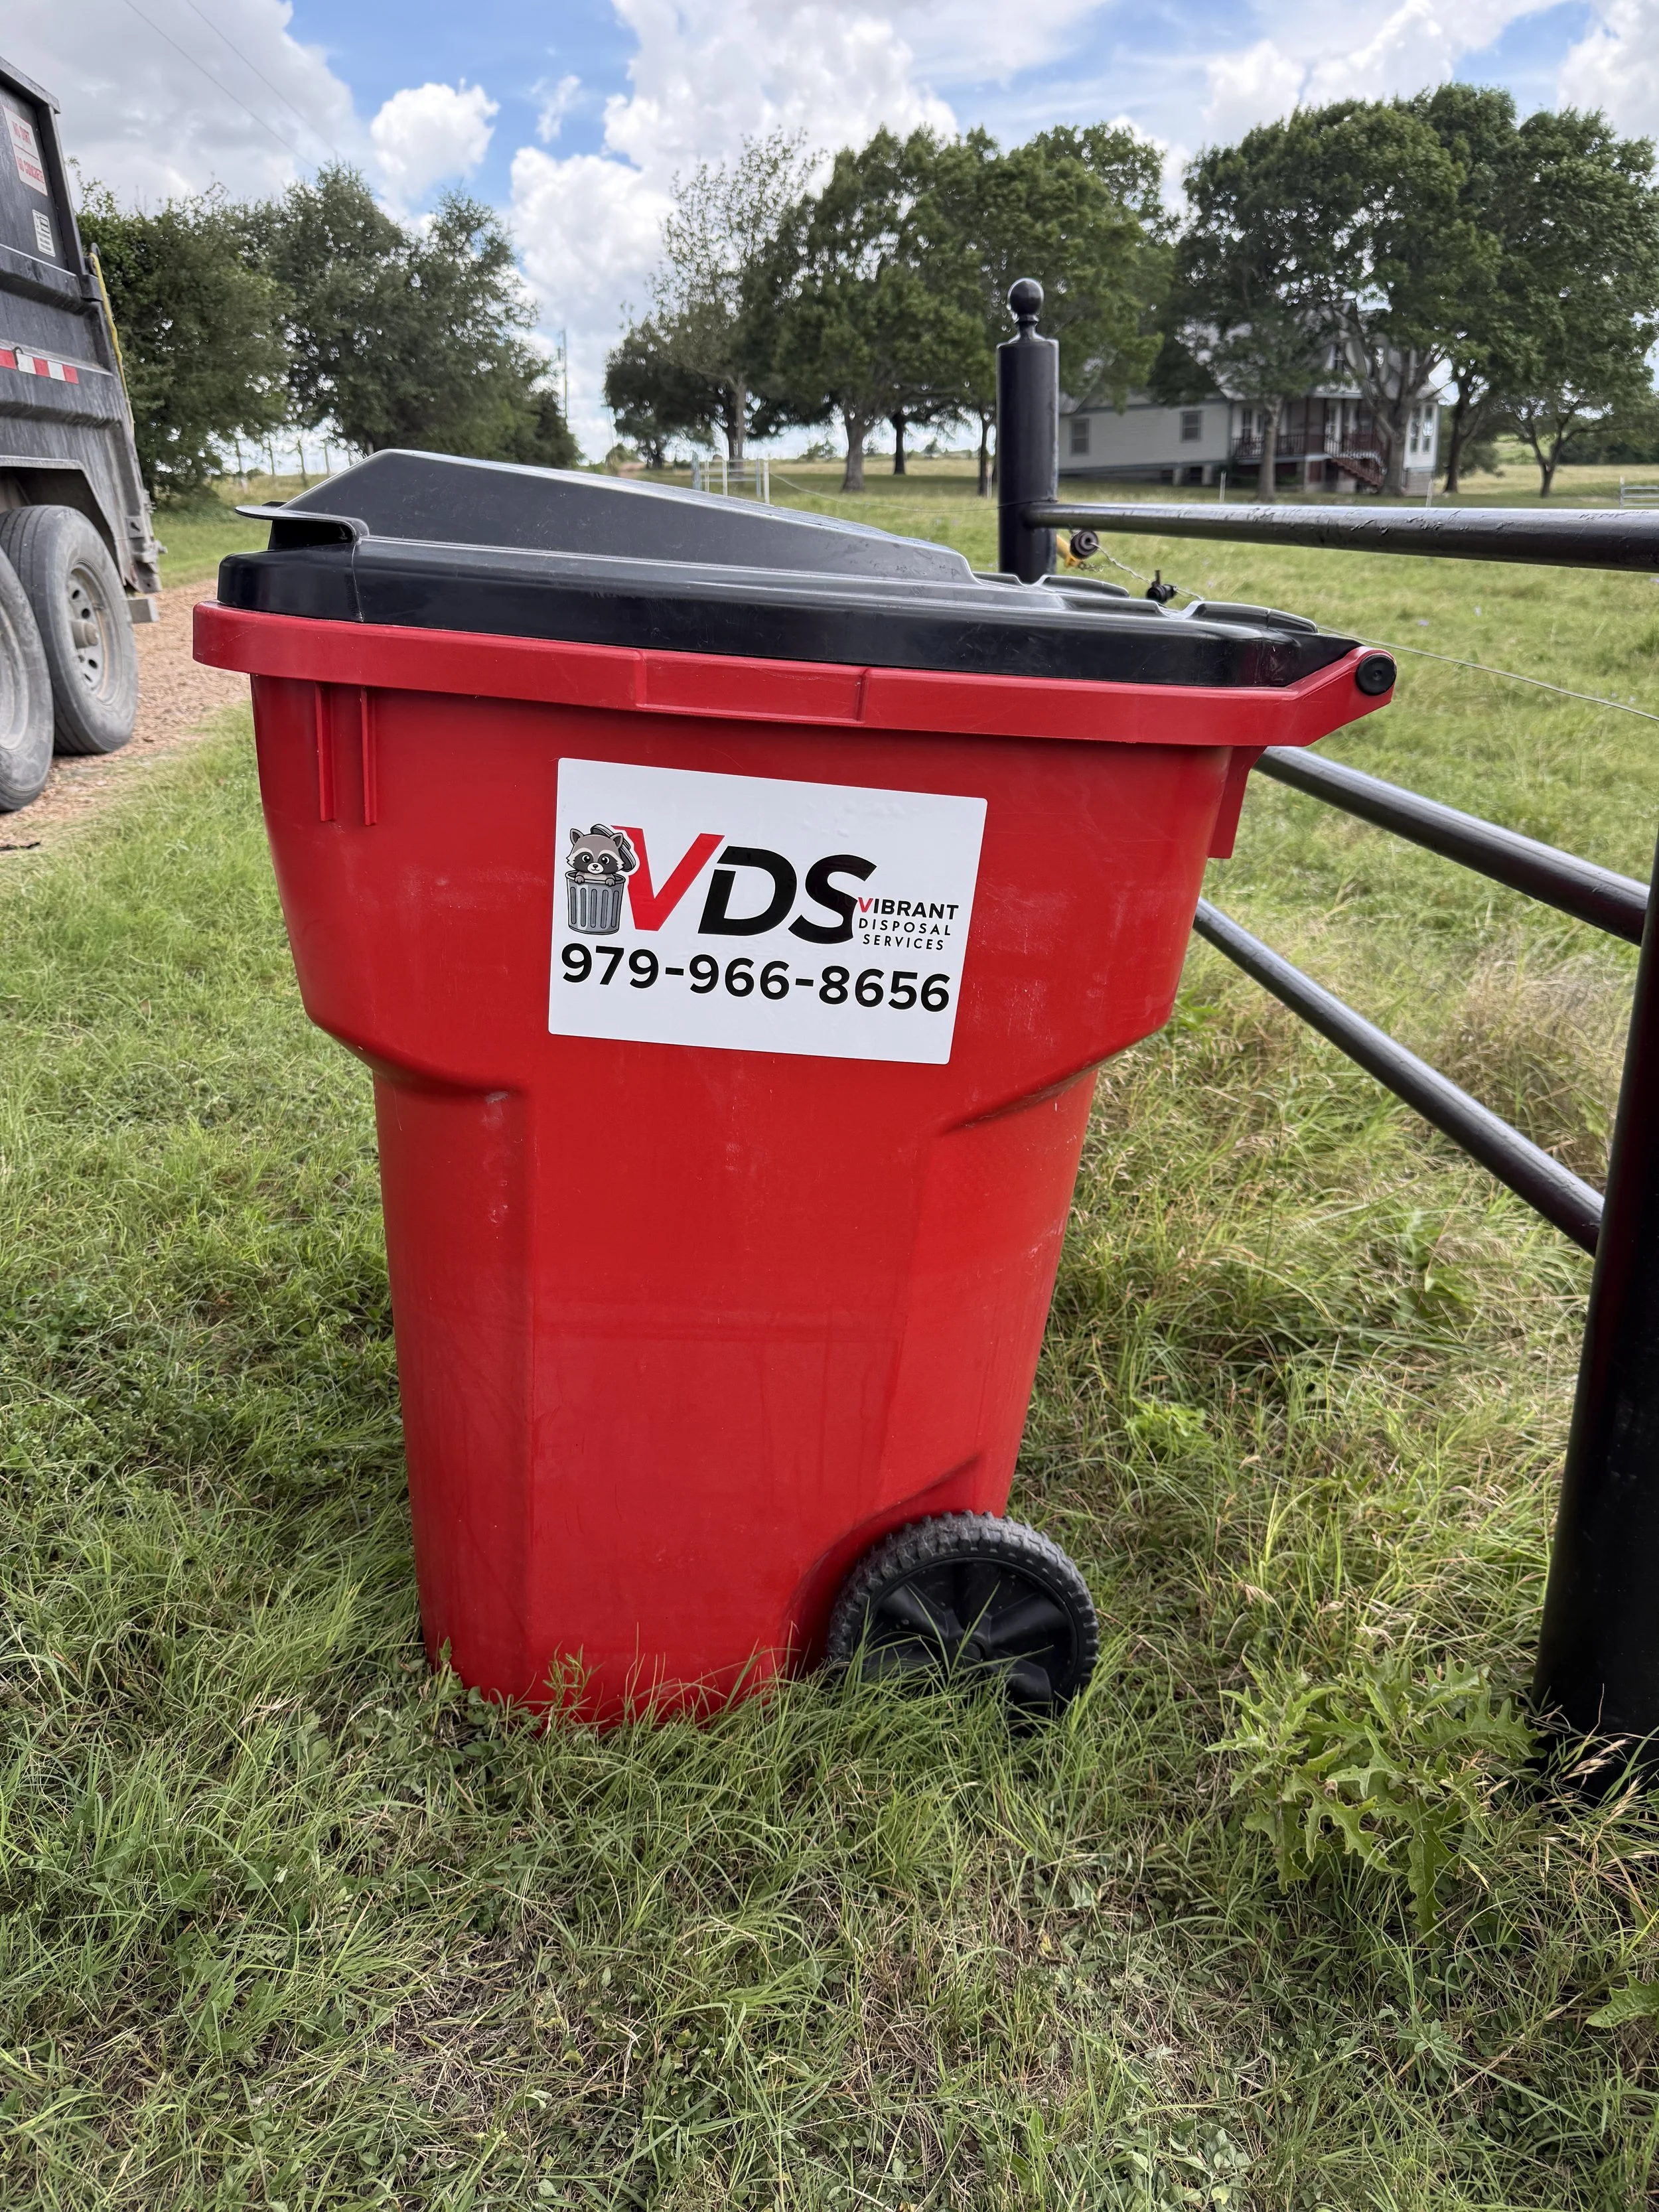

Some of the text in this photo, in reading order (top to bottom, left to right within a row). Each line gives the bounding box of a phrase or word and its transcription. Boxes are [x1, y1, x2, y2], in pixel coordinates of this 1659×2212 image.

[611, 824, 877, 944] VDS
[858, 897, 959, 920] VIBRANT
[859, 917, 950, 936] DISPOSAL
[863, 934, 944, 950] SERVICES
[561, 942, 950, 1012] 979-966-8656
